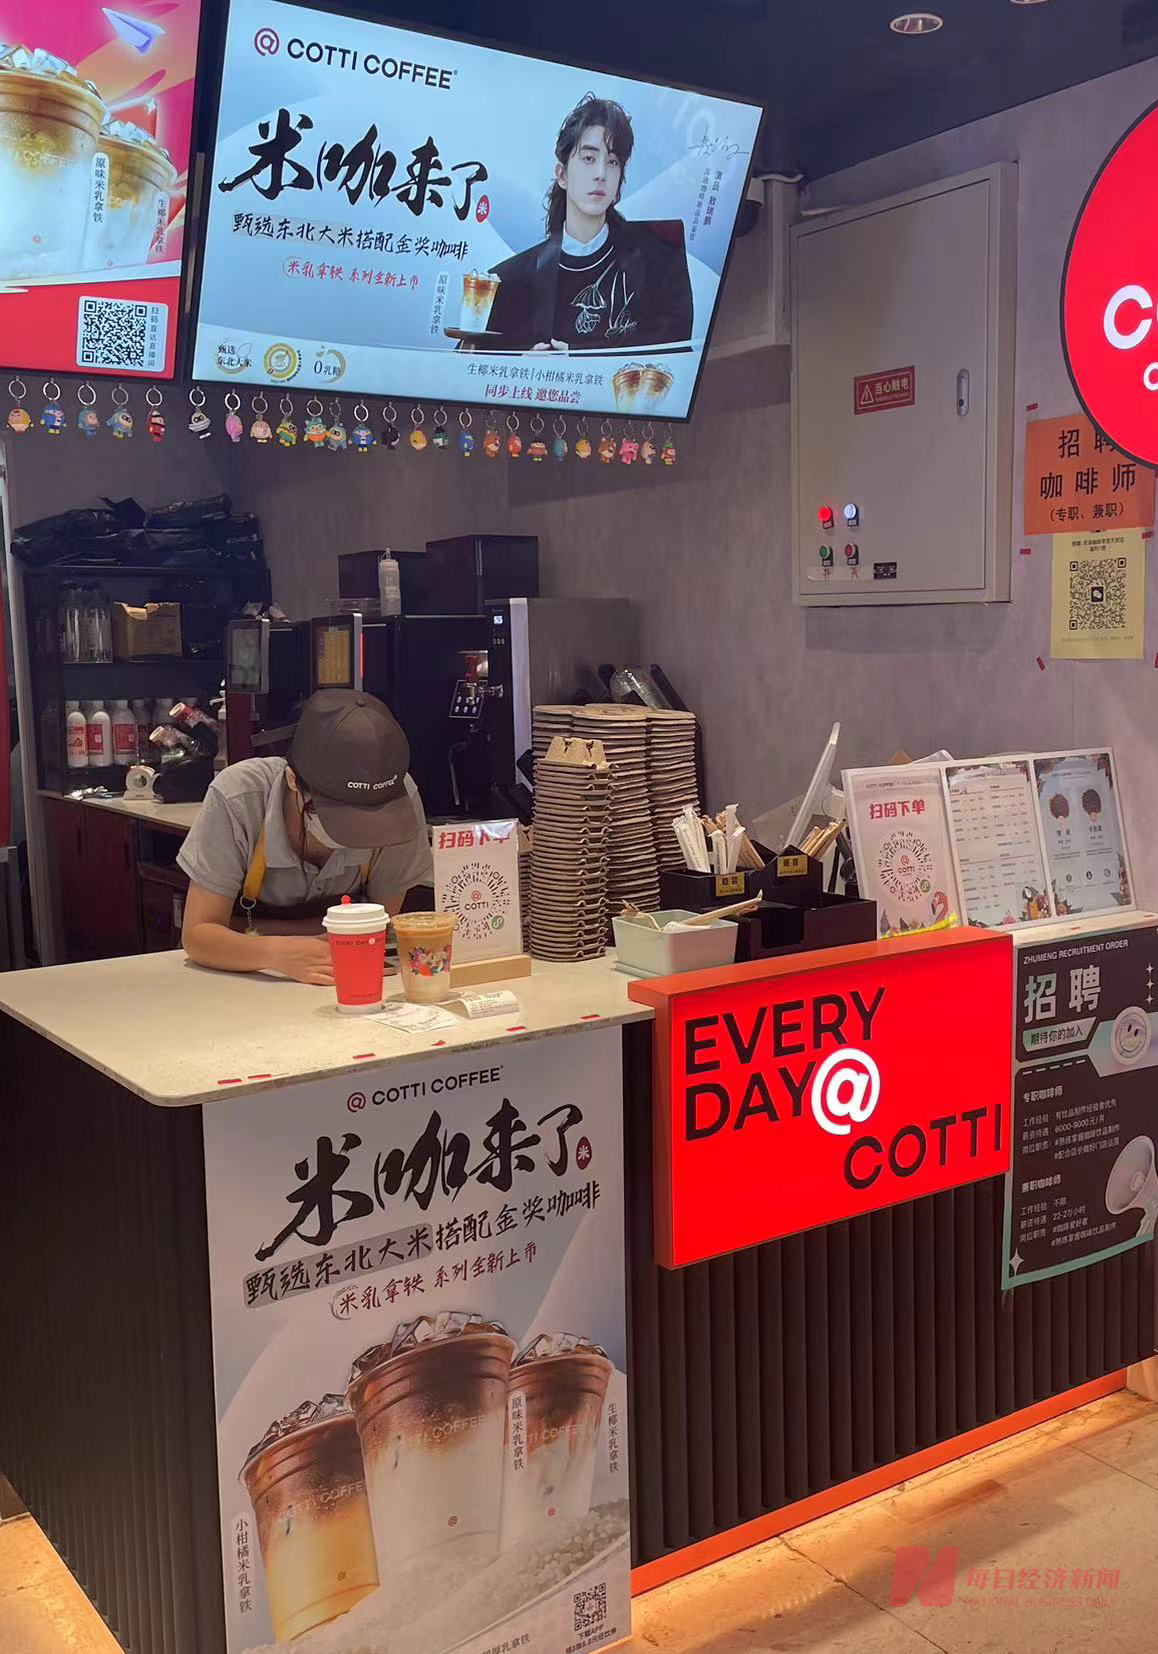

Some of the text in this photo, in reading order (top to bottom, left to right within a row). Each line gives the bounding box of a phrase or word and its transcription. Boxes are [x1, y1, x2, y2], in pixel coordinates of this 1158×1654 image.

[287, 38, 357, 71] COTTI
[364, 54, 452, 90] COFFEE
[218, 108, 488, 221] 米咖来了
[92, 156, 106, 224] 原味米乳拿铁
[233, 212, 469, 262] 甄选东北大米搭配金奖咖啡
[485, 383, 582, 405] 同步上线 邀您品尝
[875, 376, 910, 396] 当心触电
[1040, 463, 1136, 500] 咖啡师
[347, 781, 370, 790] COTTI
[869, 798, 925, 820] 扫码下单
[898, 865, 915, 874] COTTI
[464, 901, 489, 911] COTTI
[1023, 939, 1129, 965] ZHUMENG RECRUITMENT ORDER
[1024, 965, 1101, 1024] 招聘
[685, 986, 886, 1076] EVERY
[1030, 1024, 1084, 1046] 期待你的加入
[372, 1082, 426, 1106] COTTI
[432, 1068, 501, 1094] COFFEE
[1023, 1085, 1063, 1103] 专职咖啡师
[843, 1103, 1002, 1190] COTTI
[254, 1097, 584, 1262] 米咖来了
[1021, 1173, 1062, 1194] 兼职咖啡师
[245, 1180, 601, 1305] 甄选东北大米搭配金奖咖啡
[339, 1241, 537, 1315] 米乳拿铁 系列全新上市
[512, 1396, 525, 1470] 原味米乳拿铁
[607, 1402, 620, 1474] 生椰米乳拿铁
[235, 1517, 253, 1614] 小柑橘米乳拿铁
